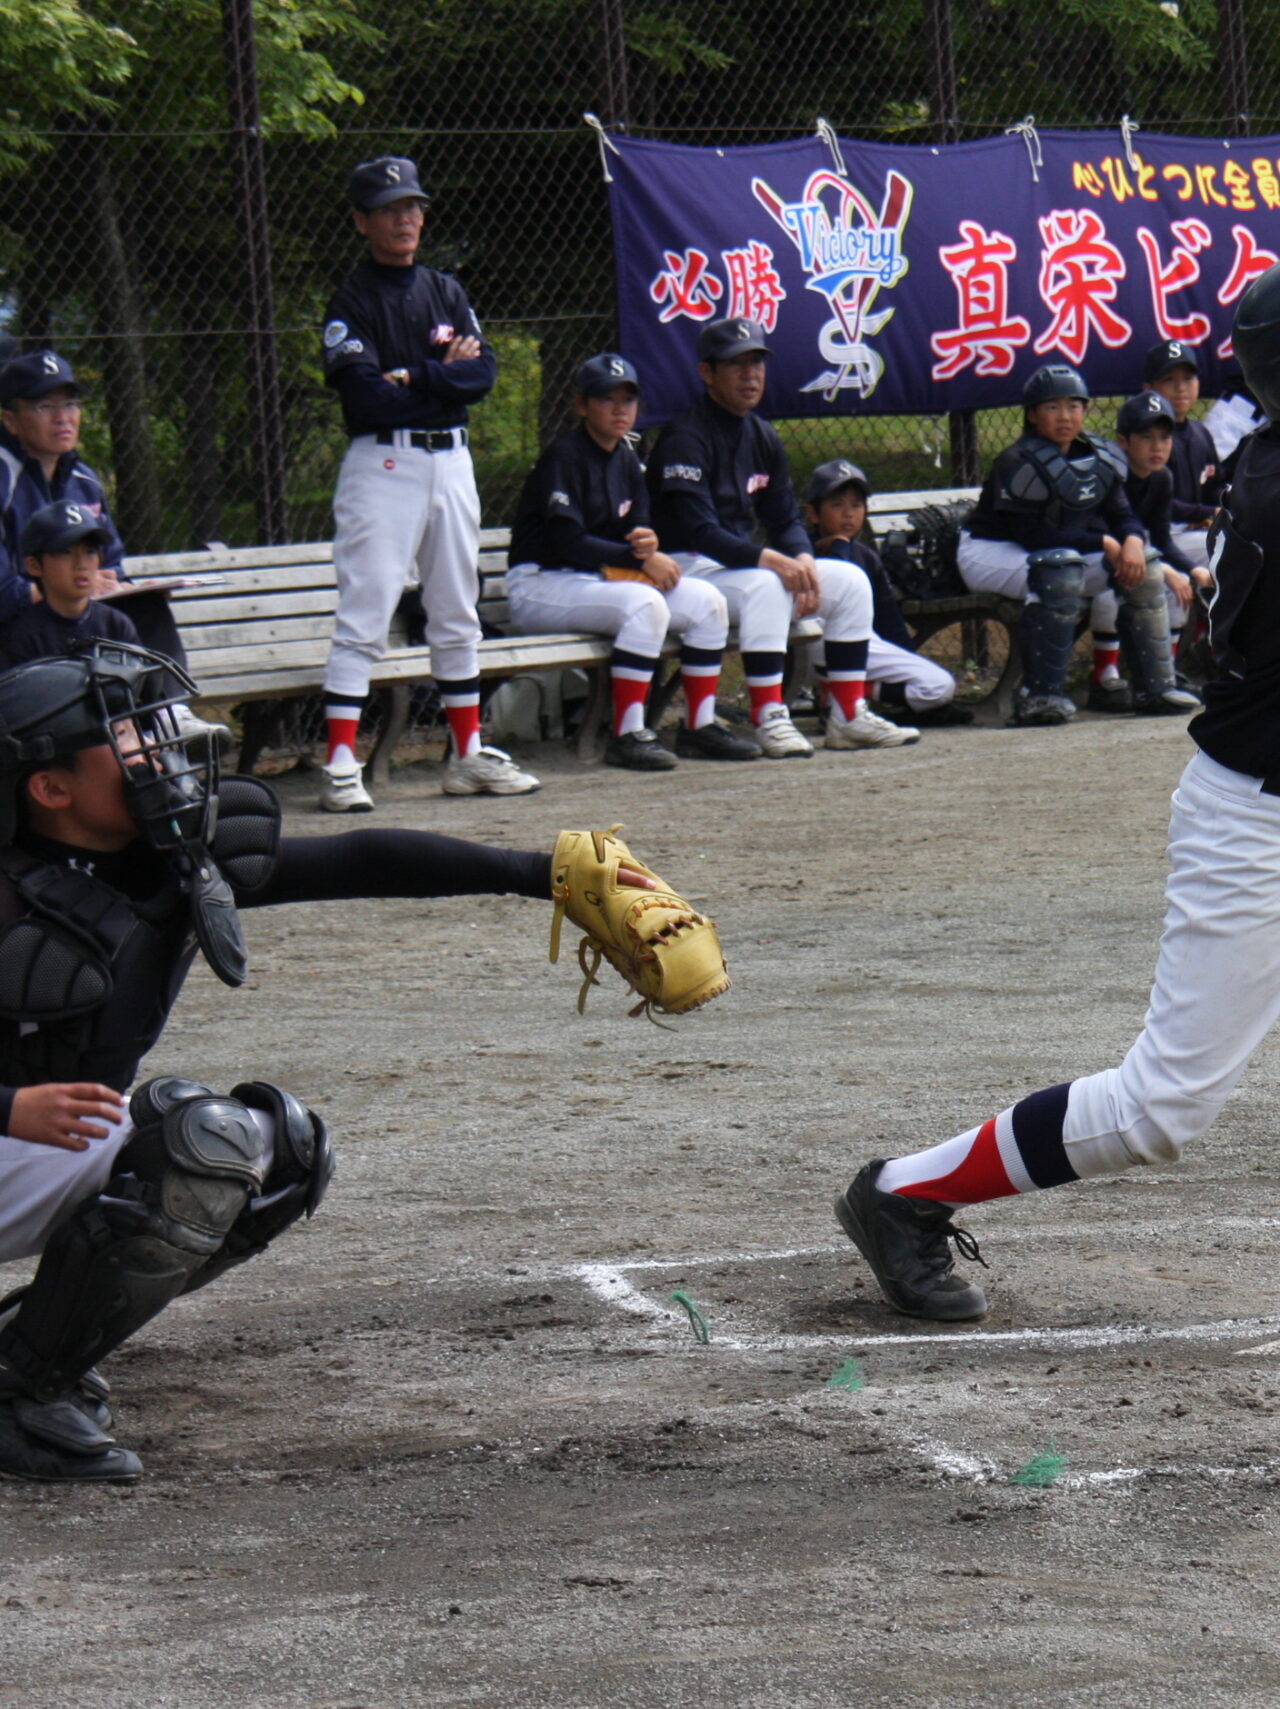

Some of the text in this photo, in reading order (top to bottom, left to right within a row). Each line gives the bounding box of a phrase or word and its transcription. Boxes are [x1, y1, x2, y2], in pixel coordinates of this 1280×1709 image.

[386, 164, 401, 185] S
[782, 201, 908, 285] Victory
[650, 239, 786, 334] 必勝
[737, 322, 751, 341] S
[1168, 341, 1182, 359] S
[43, 354, 59, 375] S
[610, 359, 625, 377] S
[1148, 396, 1162, 413] S
[65, 504, 84, 525] S
